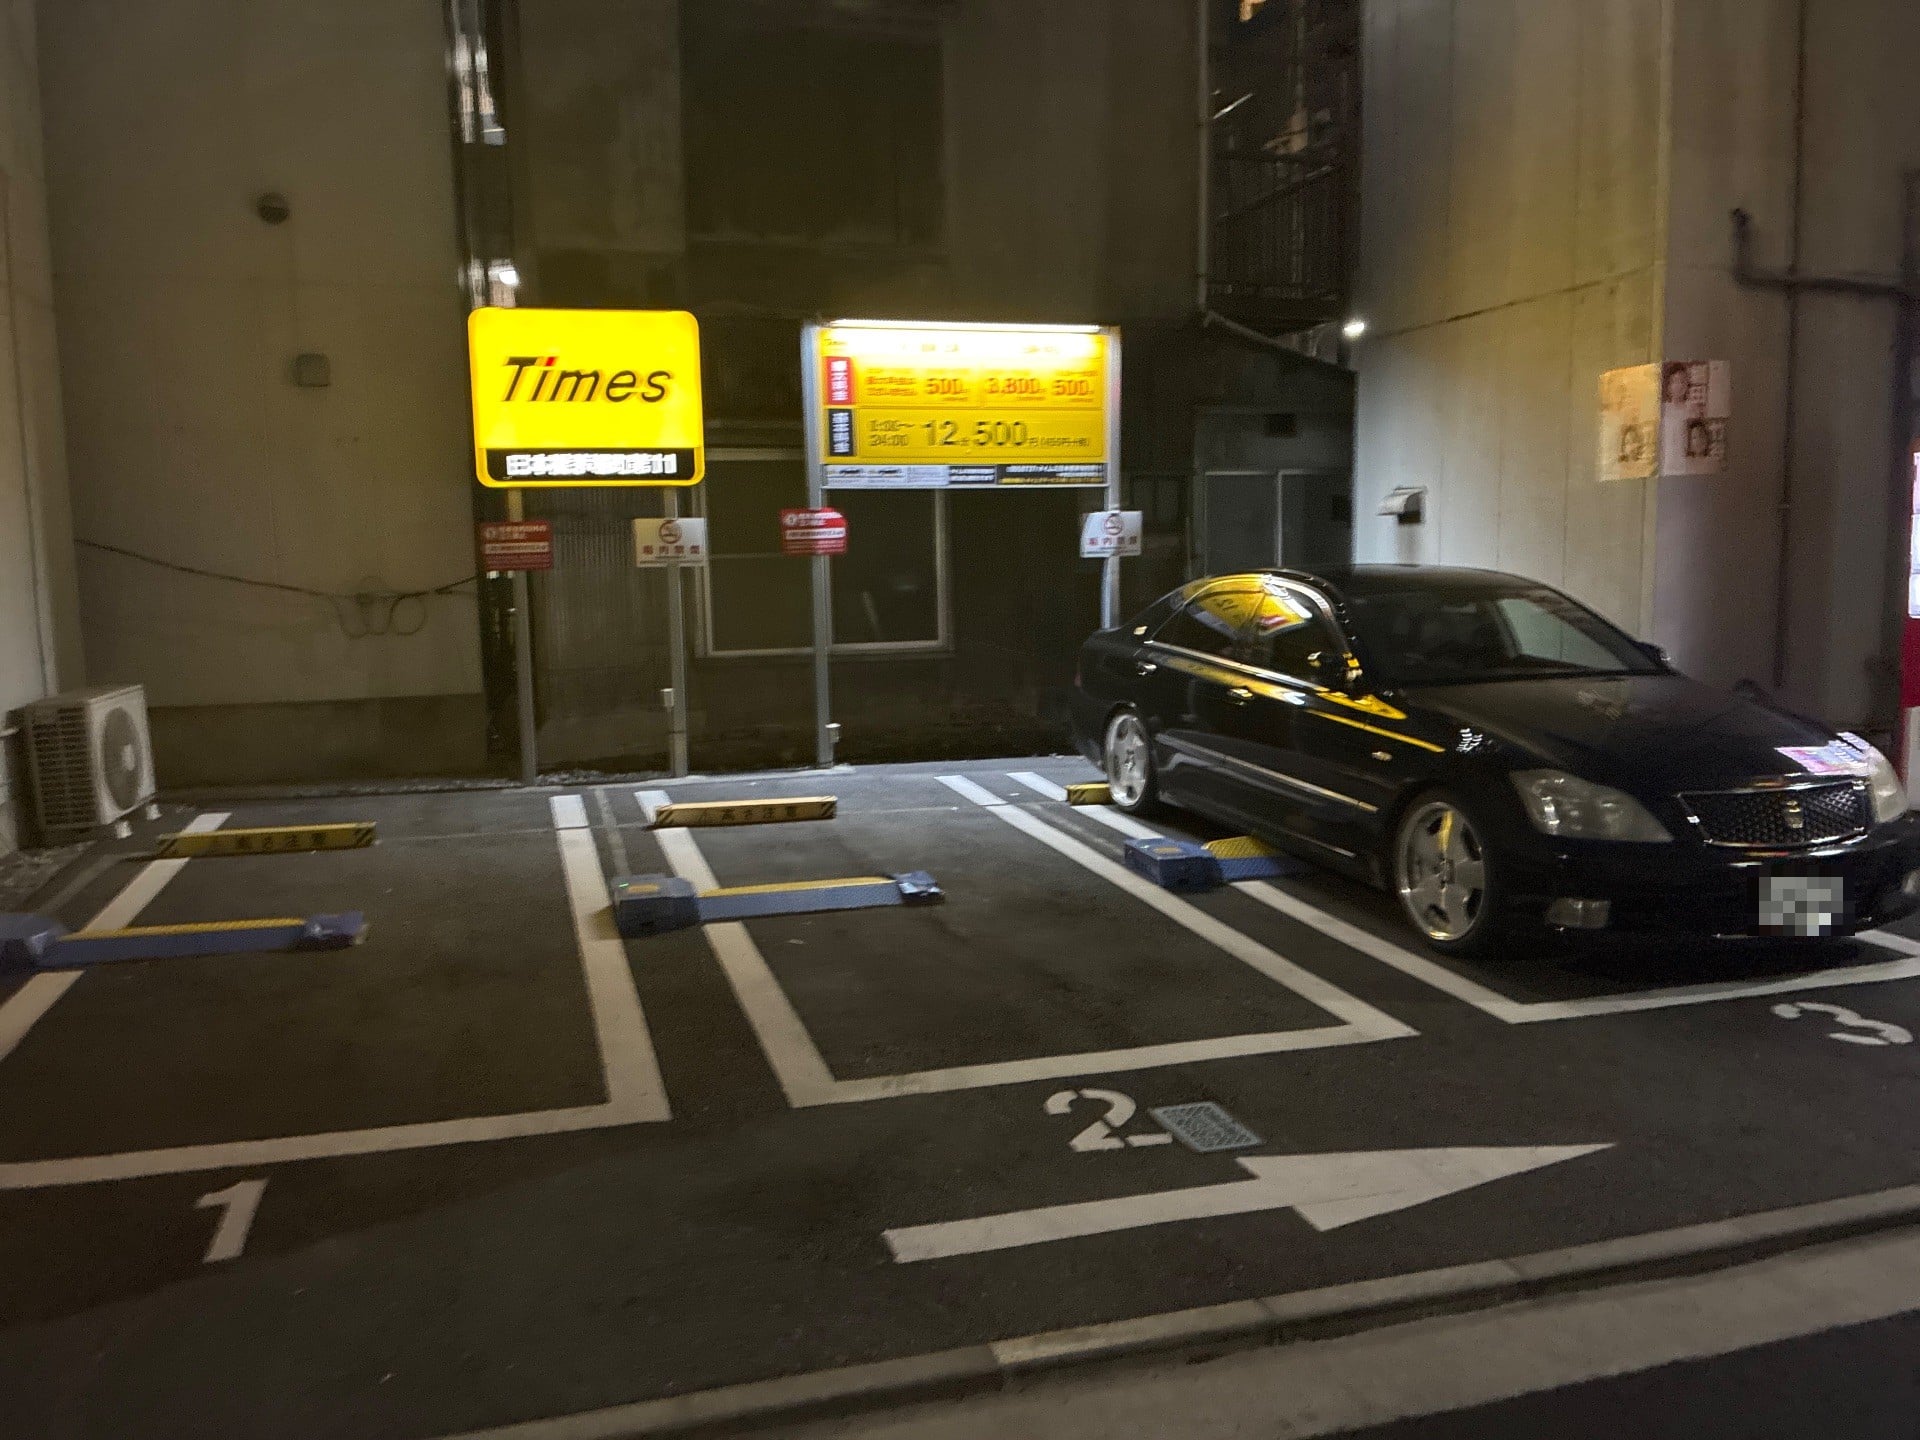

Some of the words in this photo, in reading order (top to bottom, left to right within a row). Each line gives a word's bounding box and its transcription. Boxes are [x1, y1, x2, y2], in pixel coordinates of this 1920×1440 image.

[503, 356, 673, 402] Times
[1770, 1002, 1913, 1045] 3
[1045, 1088, 1173, 1153] 2
[194, 1178, 269, 1263] 1
